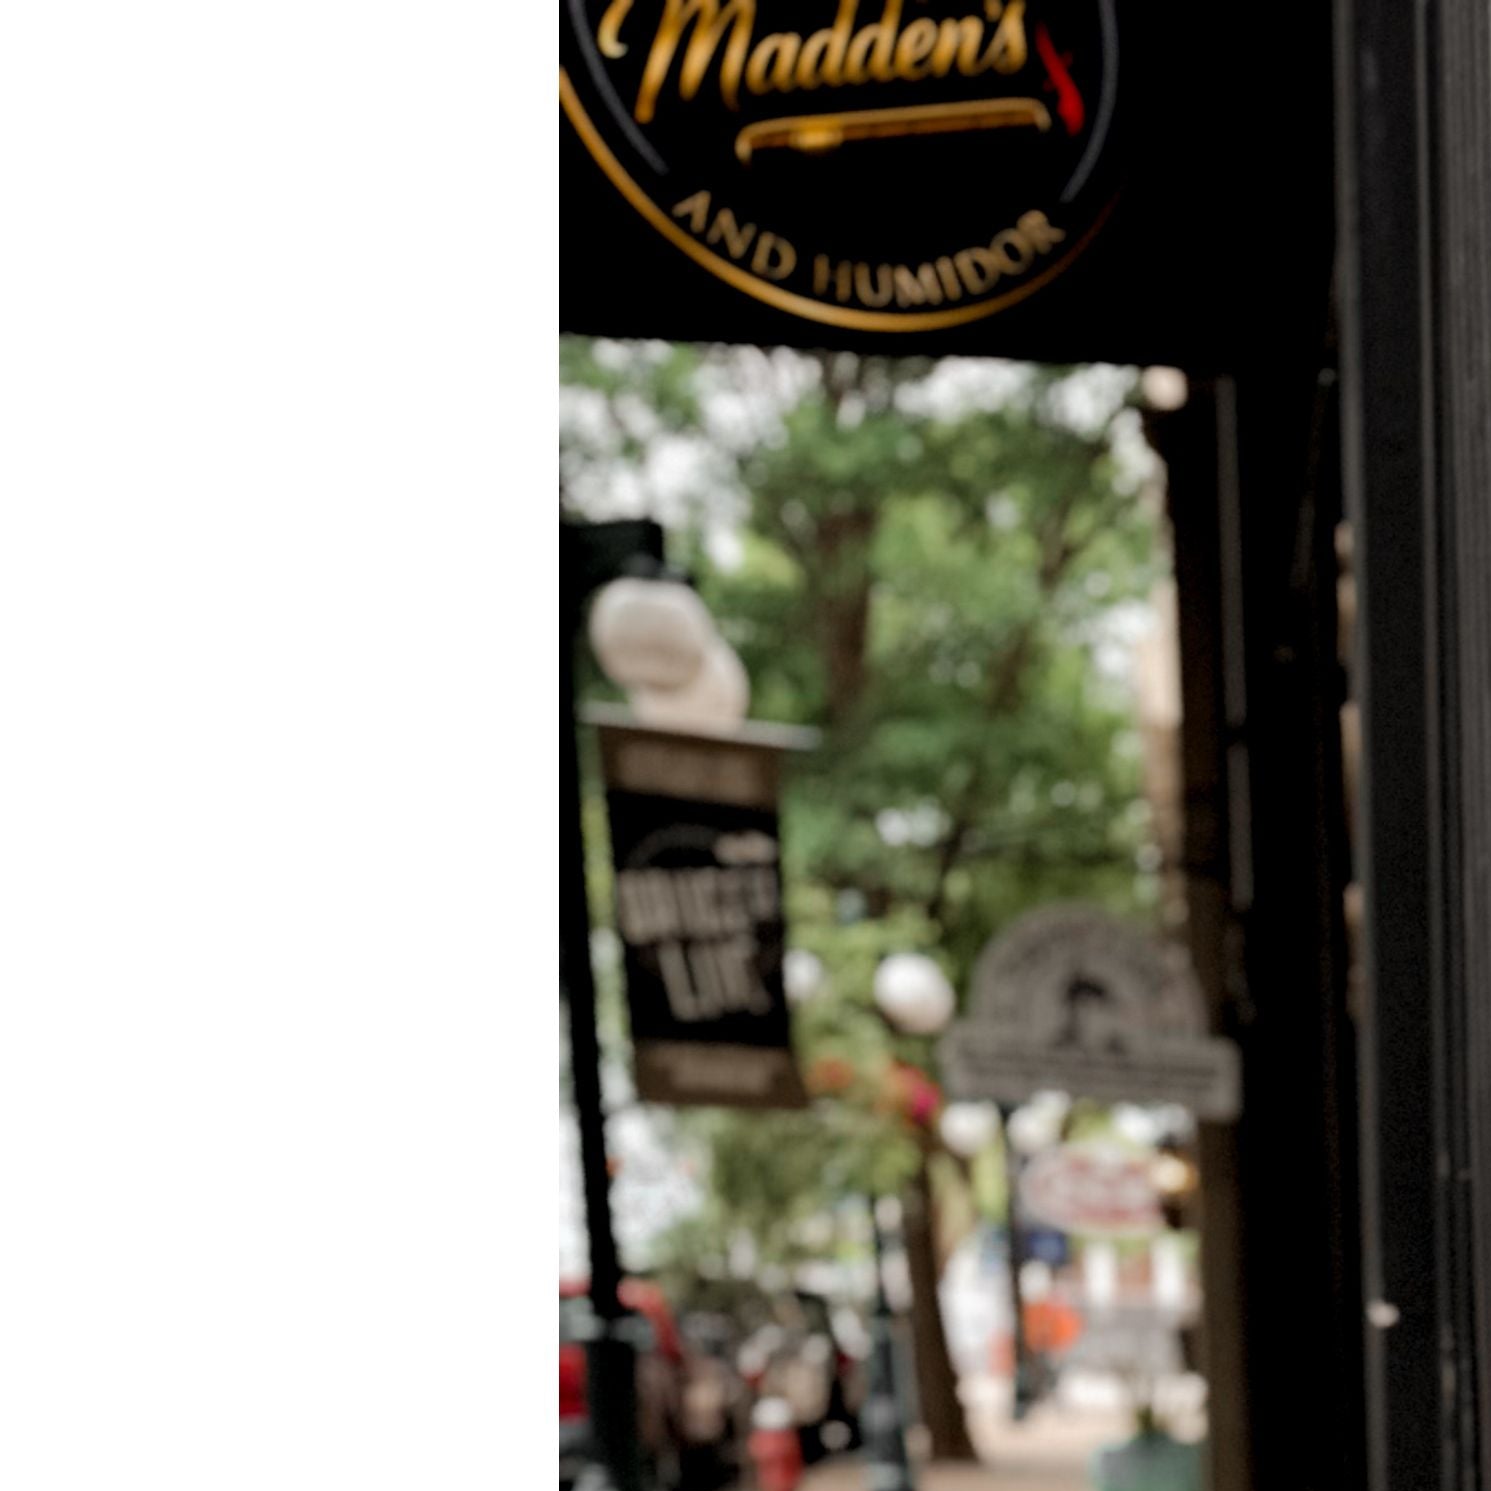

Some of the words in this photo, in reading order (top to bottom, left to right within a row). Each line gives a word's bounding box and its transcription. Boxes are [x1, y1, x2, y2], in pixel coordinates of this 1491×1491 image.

[599, 0, 1028, 123] Madden's
[673, 189, 798, 281] AND
[812, 209, 1065, 308] HUMIDOR
